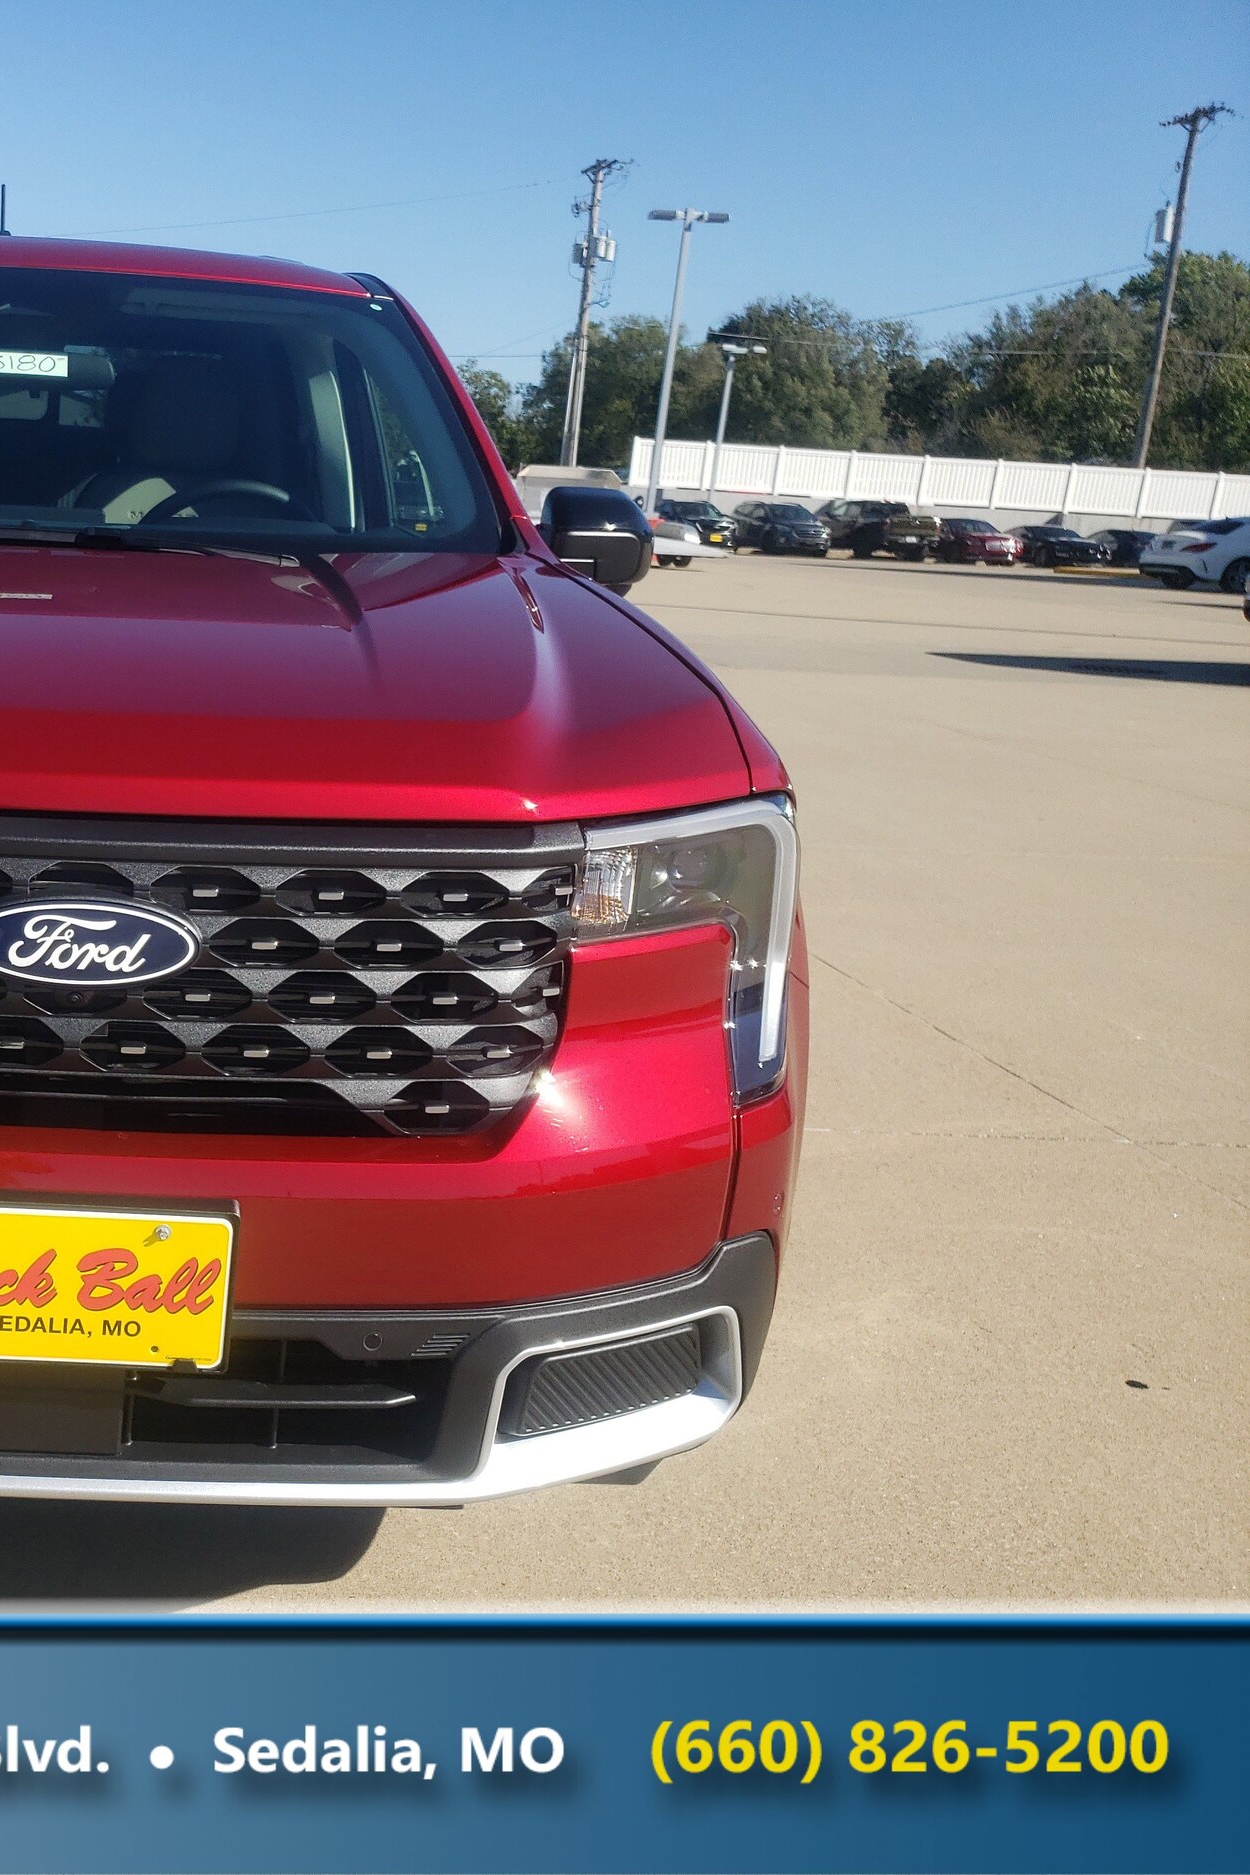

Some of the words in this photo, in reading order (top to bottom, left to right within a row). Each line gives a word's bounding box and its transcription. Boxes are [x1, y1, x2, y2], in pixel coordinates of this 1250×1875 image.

[7, 914, 152, 973] Ford
[77, 1247, 222, 1315] Ball
[102, 1319, 142, 1338] MO
